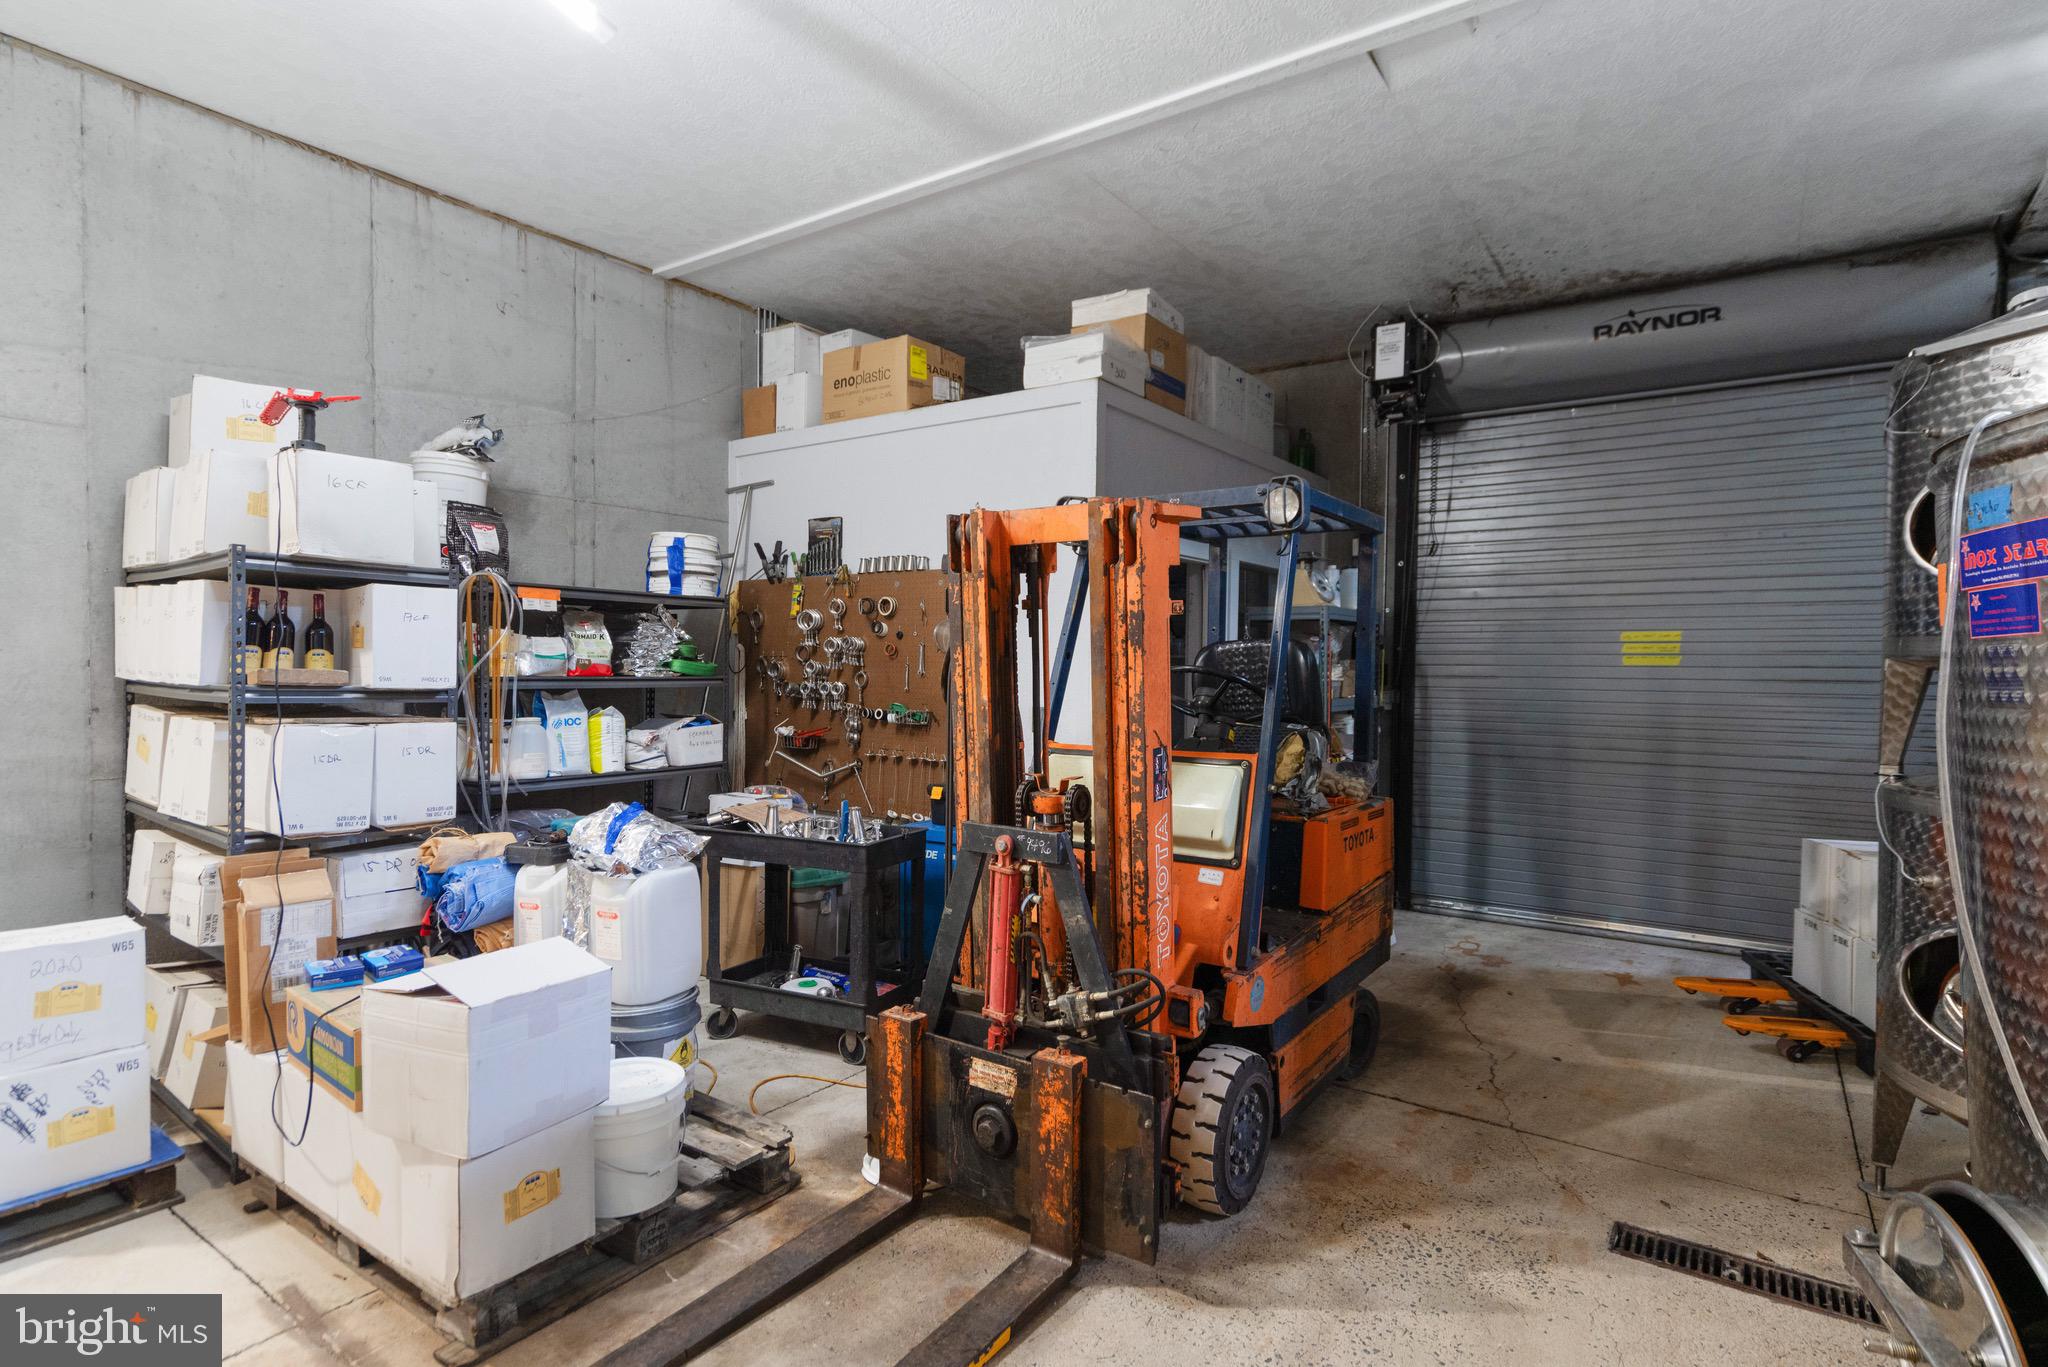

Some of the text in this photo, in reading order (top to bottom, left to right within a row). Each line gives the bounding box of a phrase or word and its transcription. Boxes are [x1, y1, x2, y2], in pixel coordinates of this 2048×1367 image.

[1593, 306, 1725, 341] RAYNOR
[833, 366, 891, 390] enoplastic
[926, 363, 957, 383] RAGILE
[564, 717, 582, 727] IOC
[1343, 832, 1375, 854] TOYOTA
[363, 861, 379, 873] 15
[1154, 812, 1171, 969] TOYOTA
[111, 940, 135, 953] W65
[30, 953, 83, 978] 2020
